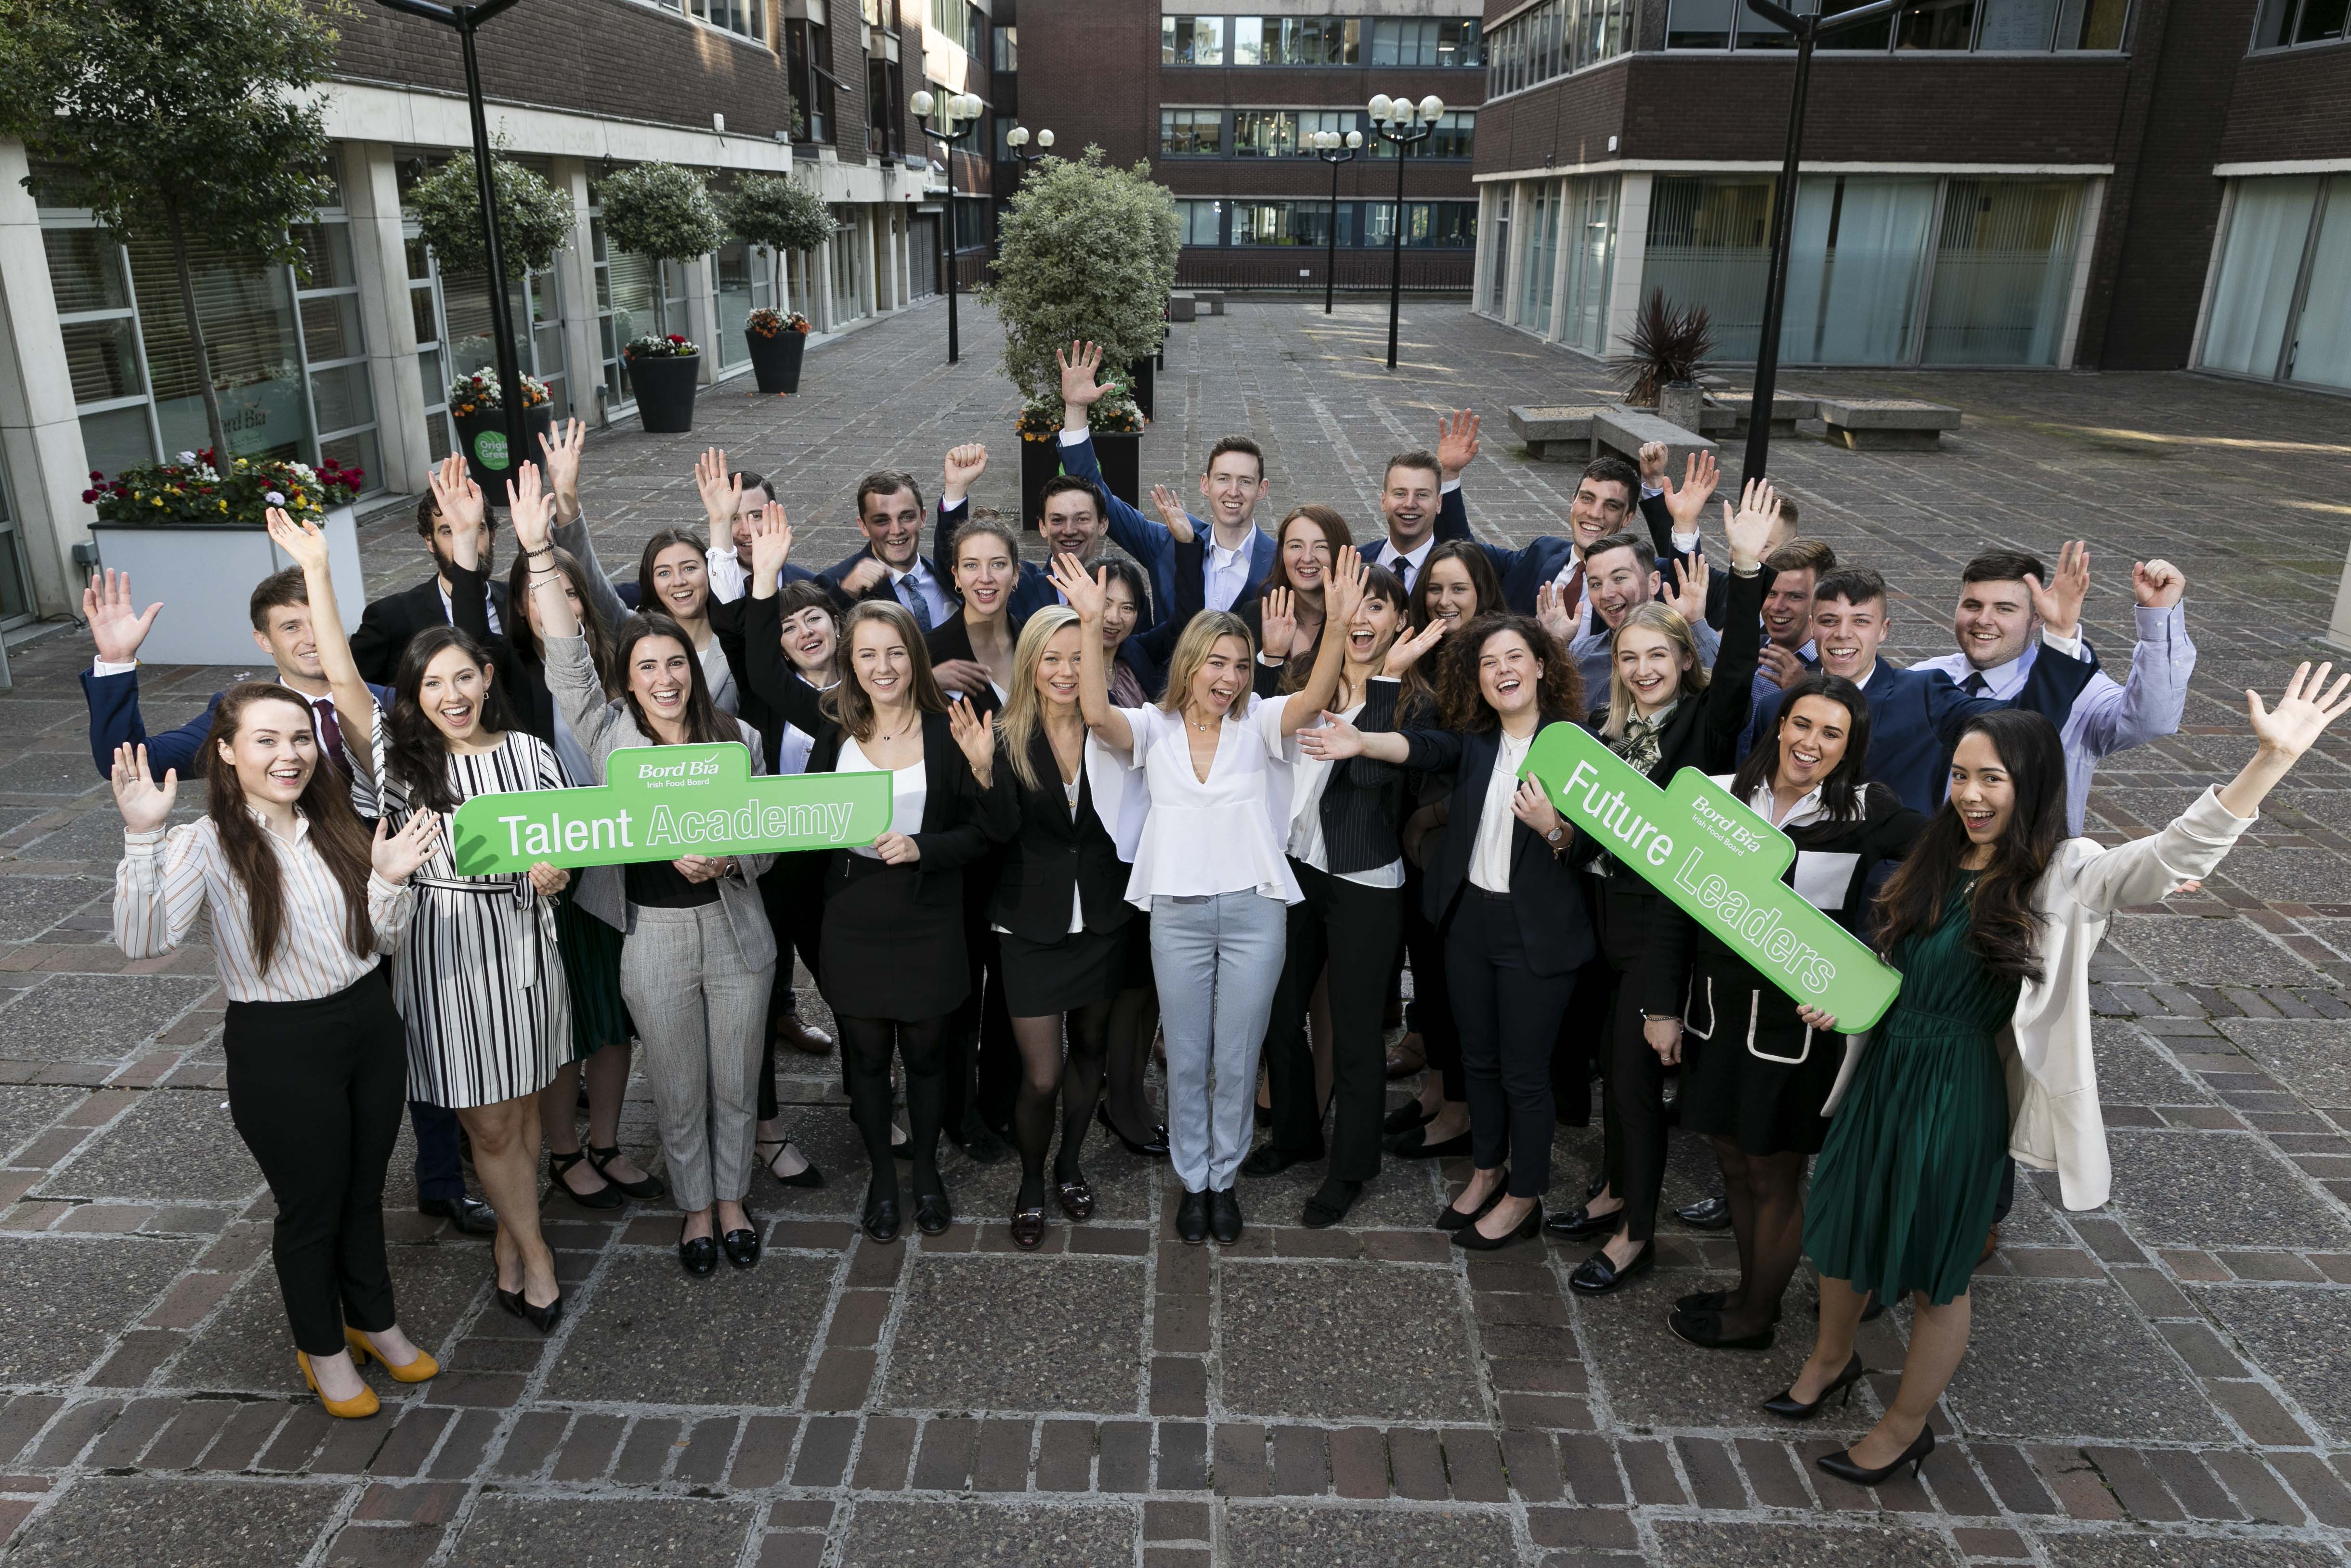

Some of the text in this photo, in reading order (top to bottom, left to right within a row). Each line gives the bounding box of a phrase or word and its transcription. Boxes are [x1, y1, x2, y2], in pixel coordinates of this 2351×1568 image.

[220, 410, 242, 434] ord
[639, 752, 719, 778] Bord Bía
[498, 799, 854, 856] Talent Academy
[1691, 794, 1769, 853] Bord Bía
[1691, 814, 1745, 856] Irish Food Board
[1562, 759, 1836, 994] Future Leaders
